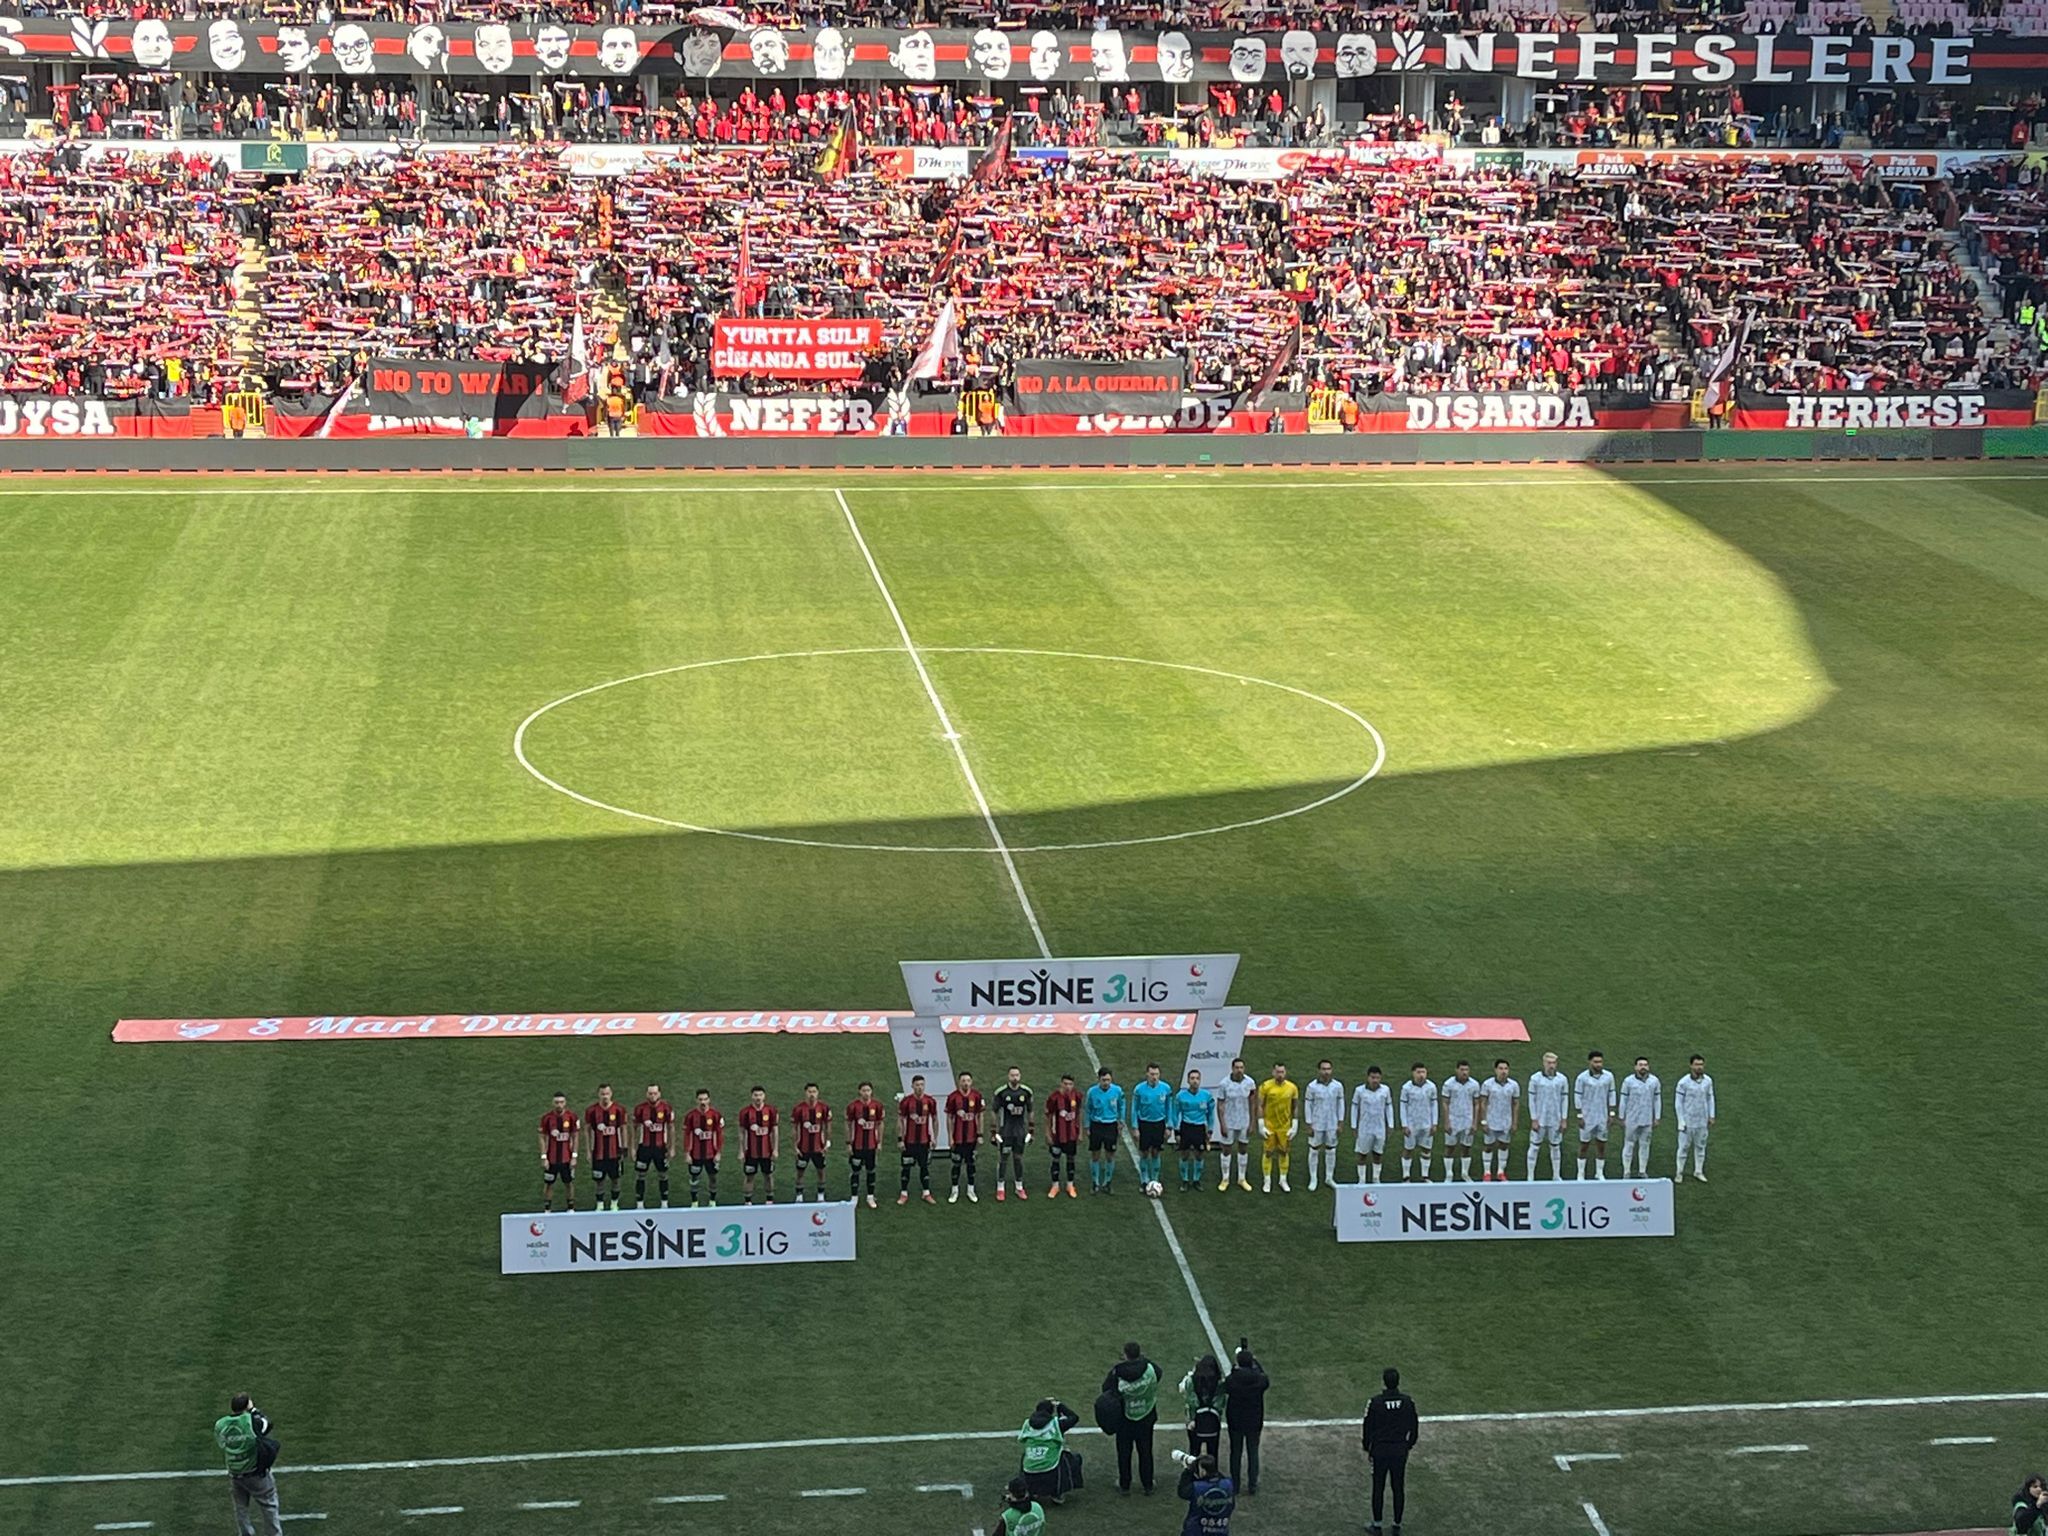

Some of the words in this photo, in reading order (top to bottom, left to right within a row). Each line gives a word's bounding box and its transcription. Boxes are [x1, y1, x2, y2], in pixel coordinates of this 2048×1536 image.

[1443, 33, 1975, 85] NEFESLERE
[1583, 164, 1638, 176] ASPAVA
[722, 326, 812, 345] YURTTA
[817, 326, 870, 345] SULH
[814, 351, 852, 368] SUL
[373, 369, 411, 393] NO
[417, 371, 452, 395] TO
[458, 373, 528, 395] WAR
[1017, 376, 1043, 393] NO
[1047, 376, 1061, 393] A
[1065, 376, 1092, 393] LA
[729, 399, 876, 431] NEFER
[1785, 395, 1986, 428] HERKESE
[248, 1018, 284, 1035] 8
[305, 1016, 437, 1034] Mart
[459, 1015, 637, 1035] Dünya
[1246, 1014, 1395, 1033] Olsun
